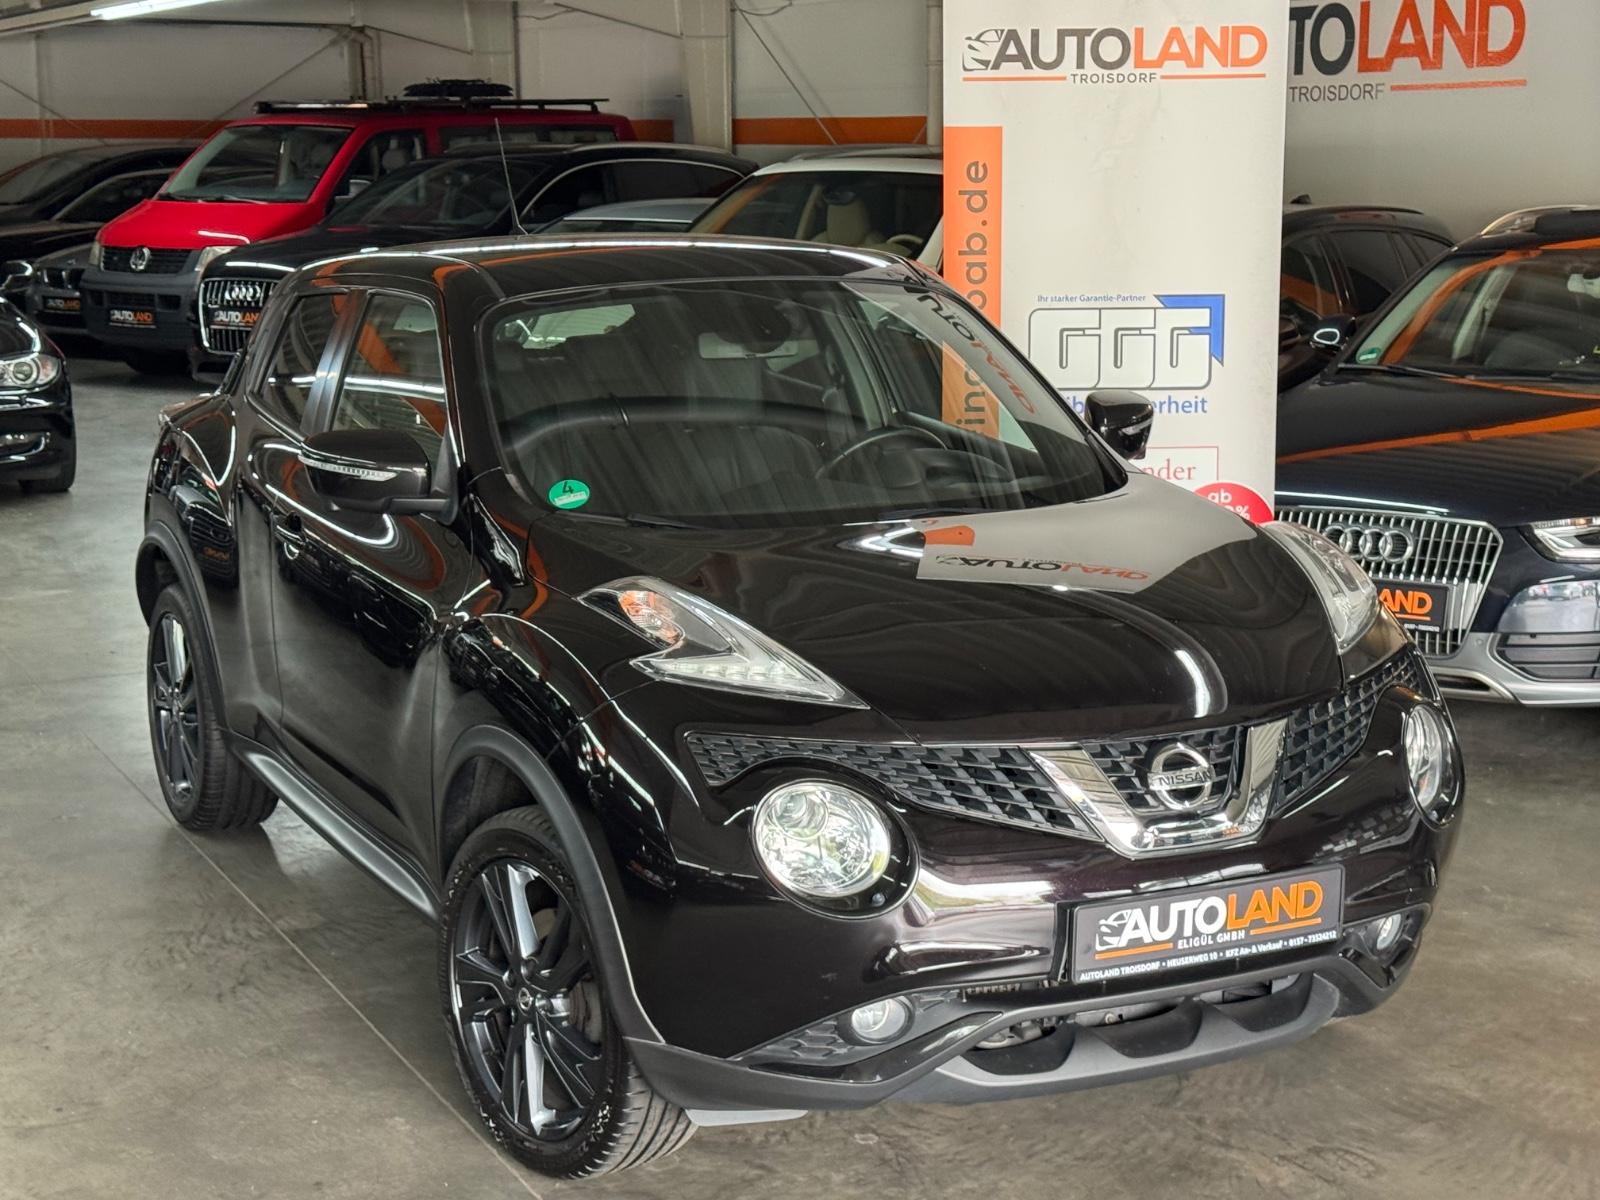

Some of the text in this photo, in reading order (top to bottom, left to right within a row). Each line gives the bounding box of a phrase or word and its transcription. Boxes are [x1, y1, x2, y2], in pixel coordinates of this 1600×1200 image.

[989, 25, 1268, 70] AUTOLAND
[1070, 72, 1157, 85] TROISDORF
[1289, 83, 1386, 102] TROISDORF
[1037, 293, 1146, 303] Ihr starker Garantie-Partner
[562, 480, 575, 494] 4
[1158, 768, 1213, 786] NISSAN
[1117, 879, 1324, 949] AUTOLAND
[1177, 929, 1246, 950] ELIGÜL GMBH
[1080, 967, 1121, 981] AUTOLAND
[1120, 961, 1161, 976] TROISDORF
